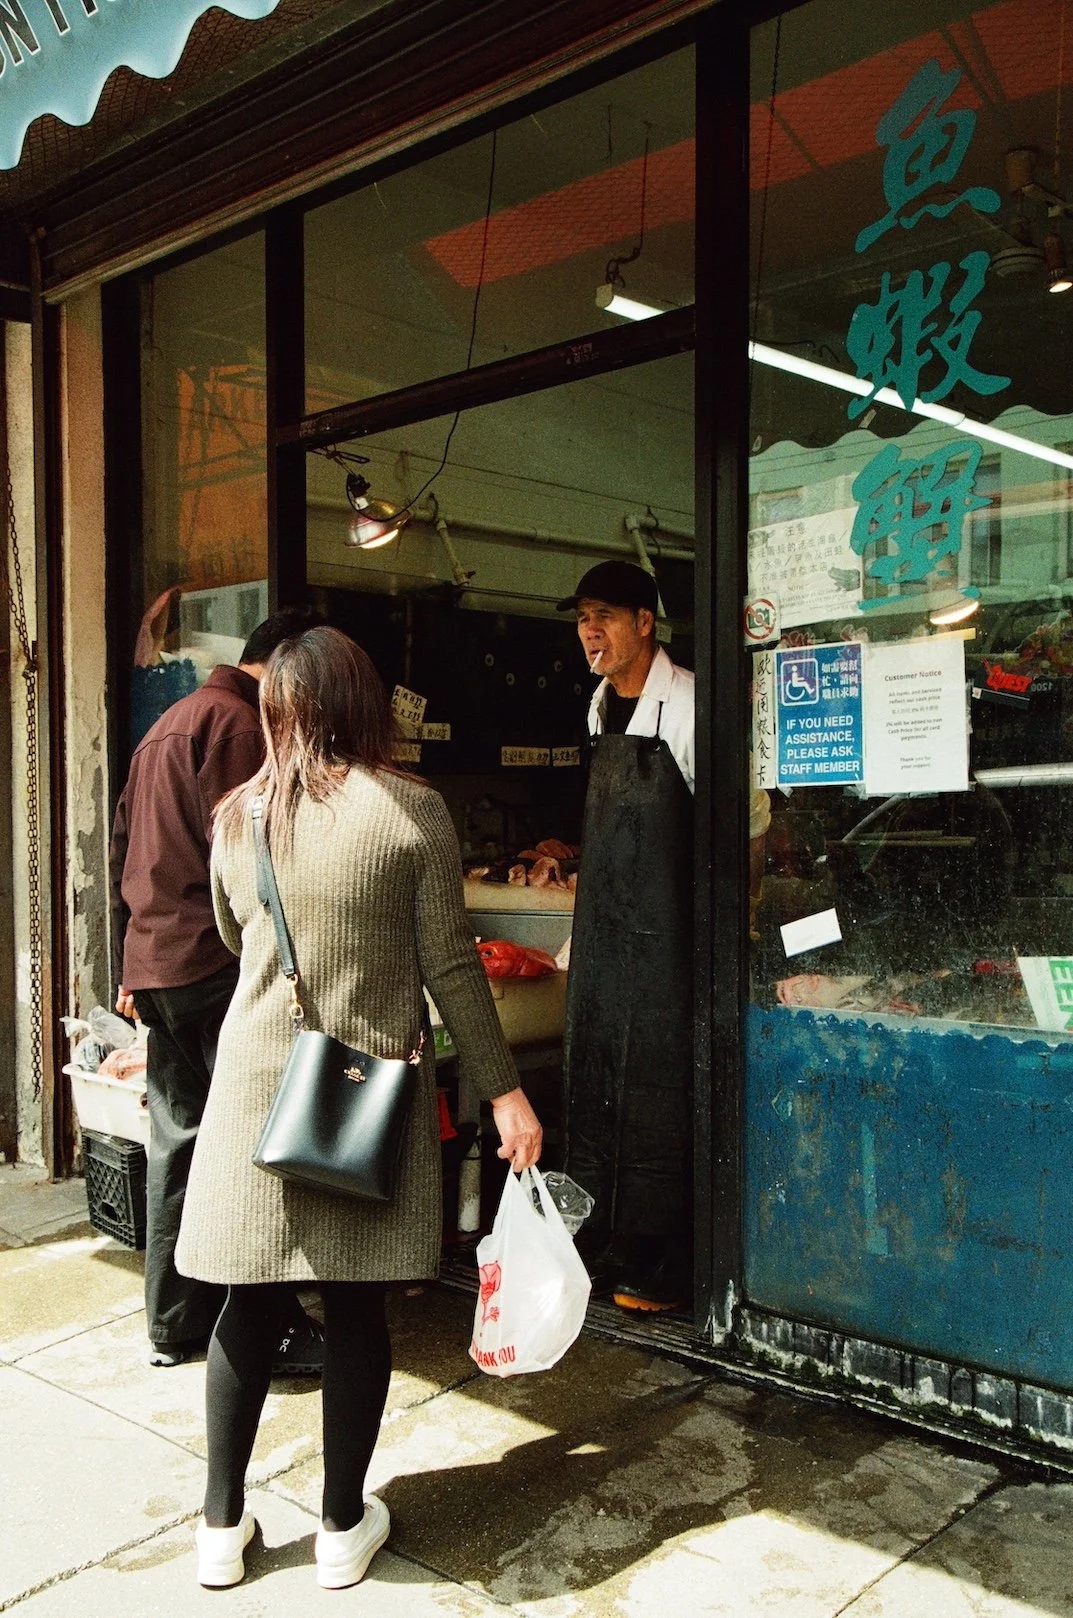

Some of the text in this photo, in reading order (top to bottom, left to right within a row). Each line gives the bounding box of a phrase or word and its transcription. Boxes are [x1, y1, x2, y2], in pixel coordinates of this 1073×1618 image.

[884, 669, 942, 682] Customer Notice
[786, 715, 854, 730] IF YOU NEED
[785, 730, 855, 745] ASSISTANCE,
[786, 745, 854, 760] PLEASE ASK
[780, 760, 860, 775] STAFF MEMBER
